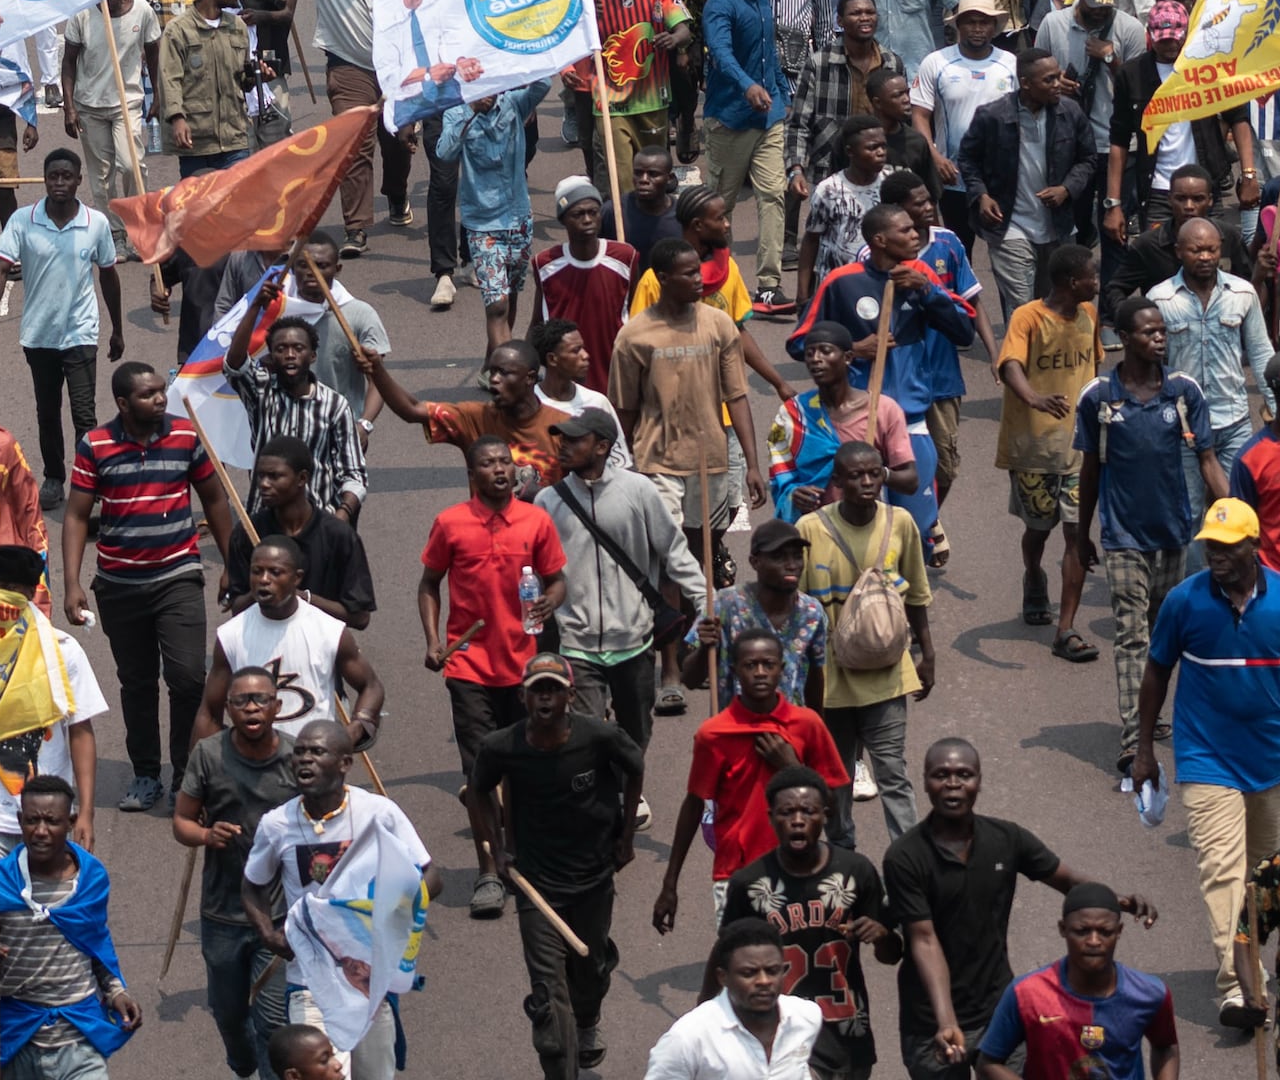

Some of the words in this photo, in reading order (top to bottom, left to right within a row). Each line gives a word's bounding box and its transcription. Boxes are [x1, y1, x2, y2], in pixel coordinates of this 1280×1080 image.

[1184, 57, 1238, 87] A.Ch
[1204, 87, 1221, 105] LE
[1222, 73, 1264, 98] POUR
[1036, 348, 1092, 370] CÉLIN
[767, 899, 844, 935] ORDA
